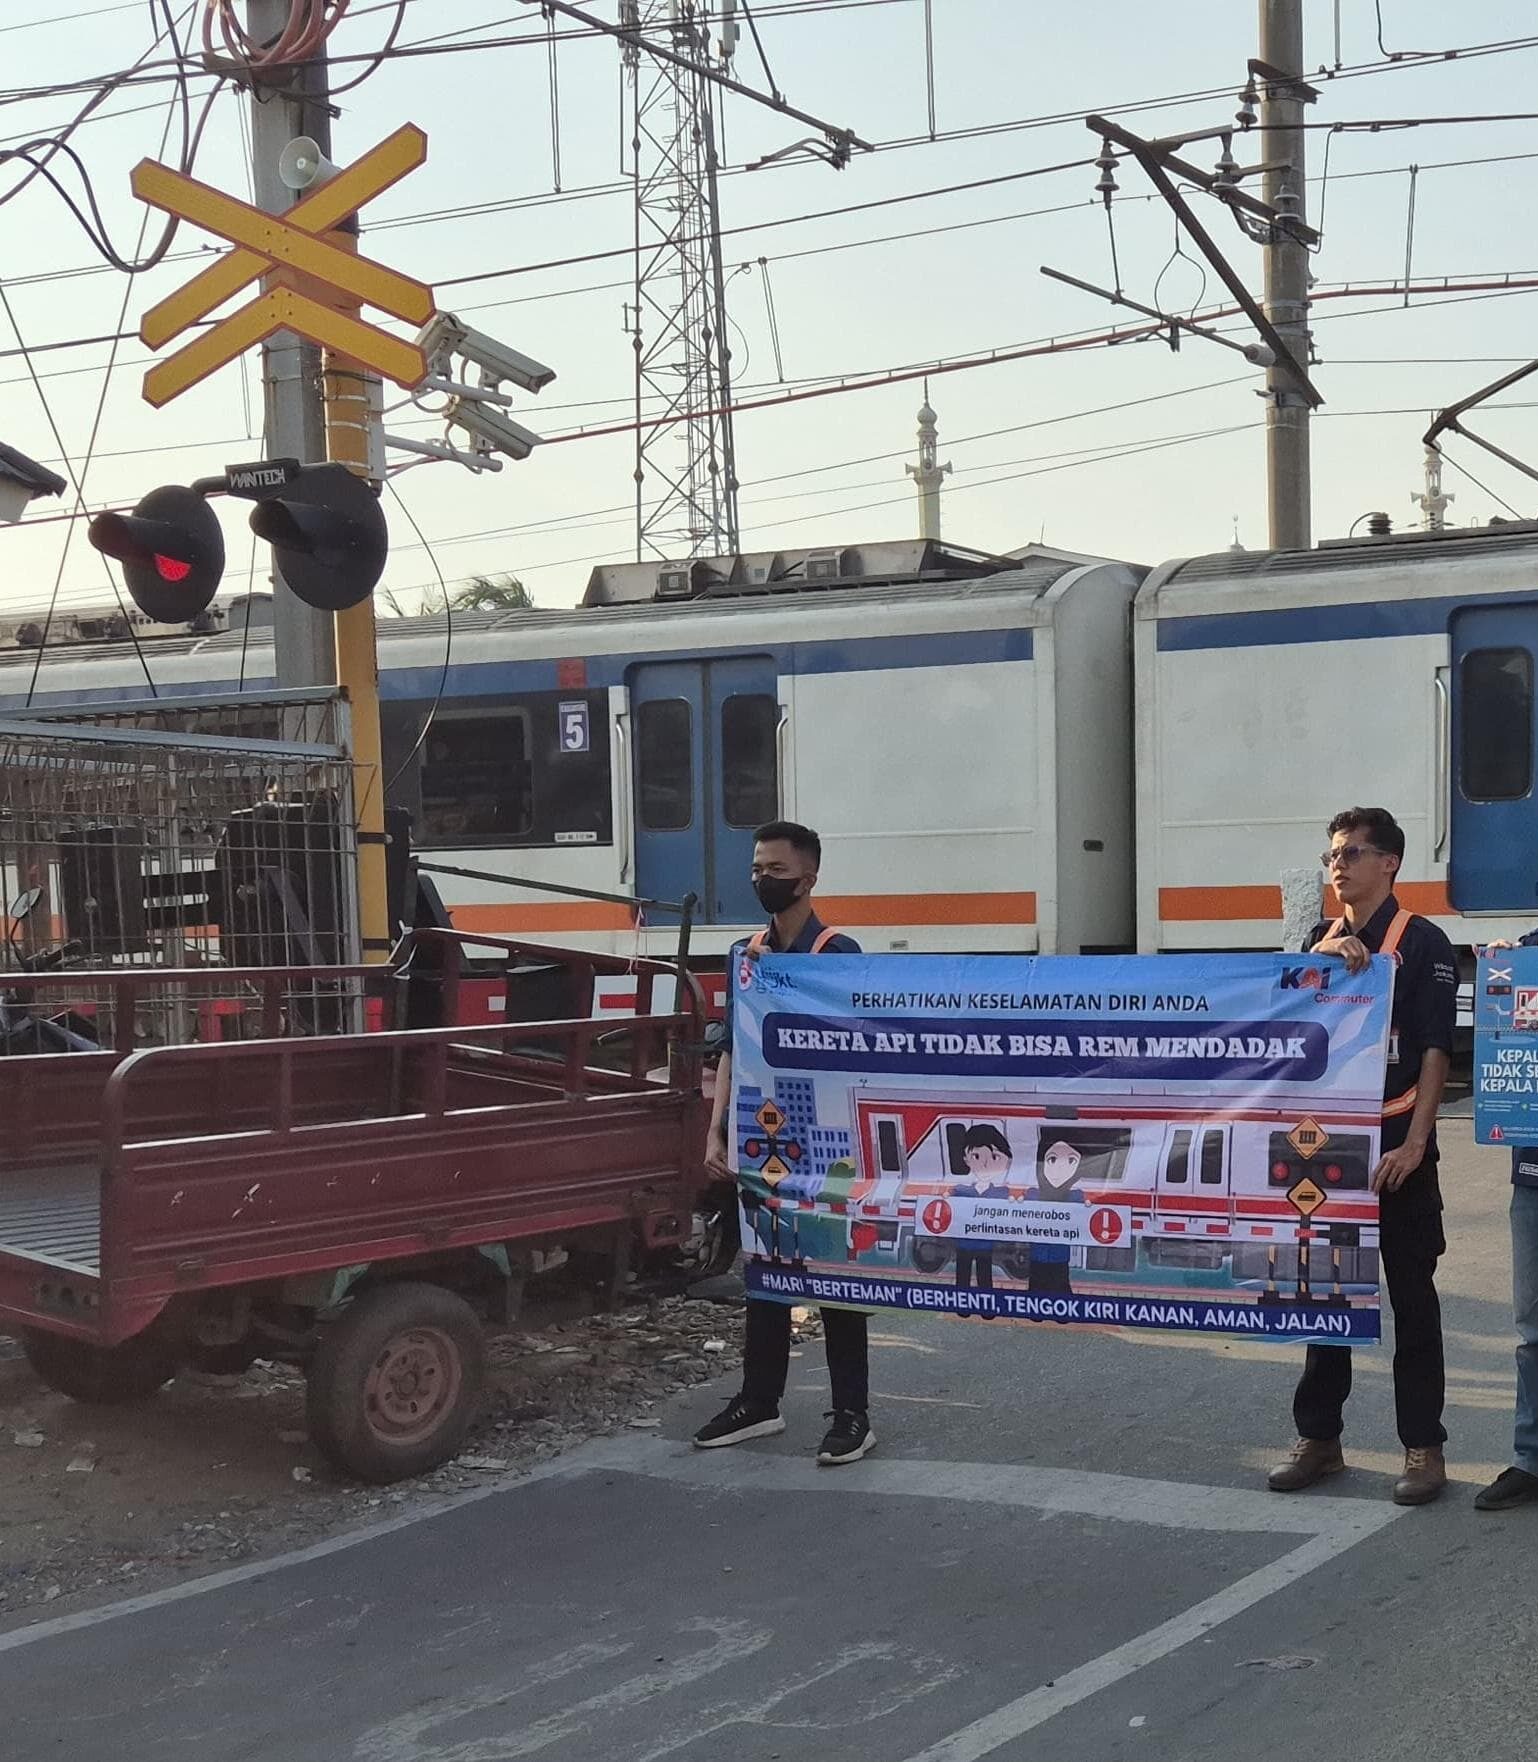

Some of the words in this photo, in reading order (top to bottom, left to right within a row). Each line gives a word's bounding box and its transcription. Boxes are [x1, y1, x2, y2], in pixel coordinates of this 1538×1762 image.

[566, 714, 584, 749] 5
[852, 992, 961, 1009] PERHATIKAN
[968, 993, 1101, 1010] KESELAMATAN
[1108, 995, 1147, 1010] DIRI
[1152, 995, 1209, 1011] ANDA
[1313, 992, 1375, 1005] Commuter
[777, 1028, 870, 1052] KERETA
[874, 1032, 915, 1053] API
[920, 1033, 1003, 1055] TIDAK
[1008, 1034, 1073, 1057] BISA
[1078, 1036, 1140, 1058] REM
[1144, 1037, 1306, 1059] MENDADAK
[1481, 1064, 1522, 1078] TIDAK
[1480, 1079, 1533, 1093] KEPALA
[973, 1205, 1009, 1219] jangan
[1012, 1207, 1071, 1221] menerobos
[964, 1223, 1024, 1236] perlintasan
[1026, 1224, 1061, 1238] kereta
[1063, 1227, 1080, 1239] api
[761, 1273, 805, 1293] #MARI
[806, 1278, 903, 1303] "BERTEMAN"
[906, 1289, 1000, 1314] (BERHENTI,
[1005, 1295, 1080, 1317] TENGOK
[1084, 1301, 1120, 1319] KIRI
[1125, 1304, 1200, 1327] KANAN,
[1203, 1309, 1271, 1331] AMAN,
[1275, 1313, 1352, 1335] JALAN)
